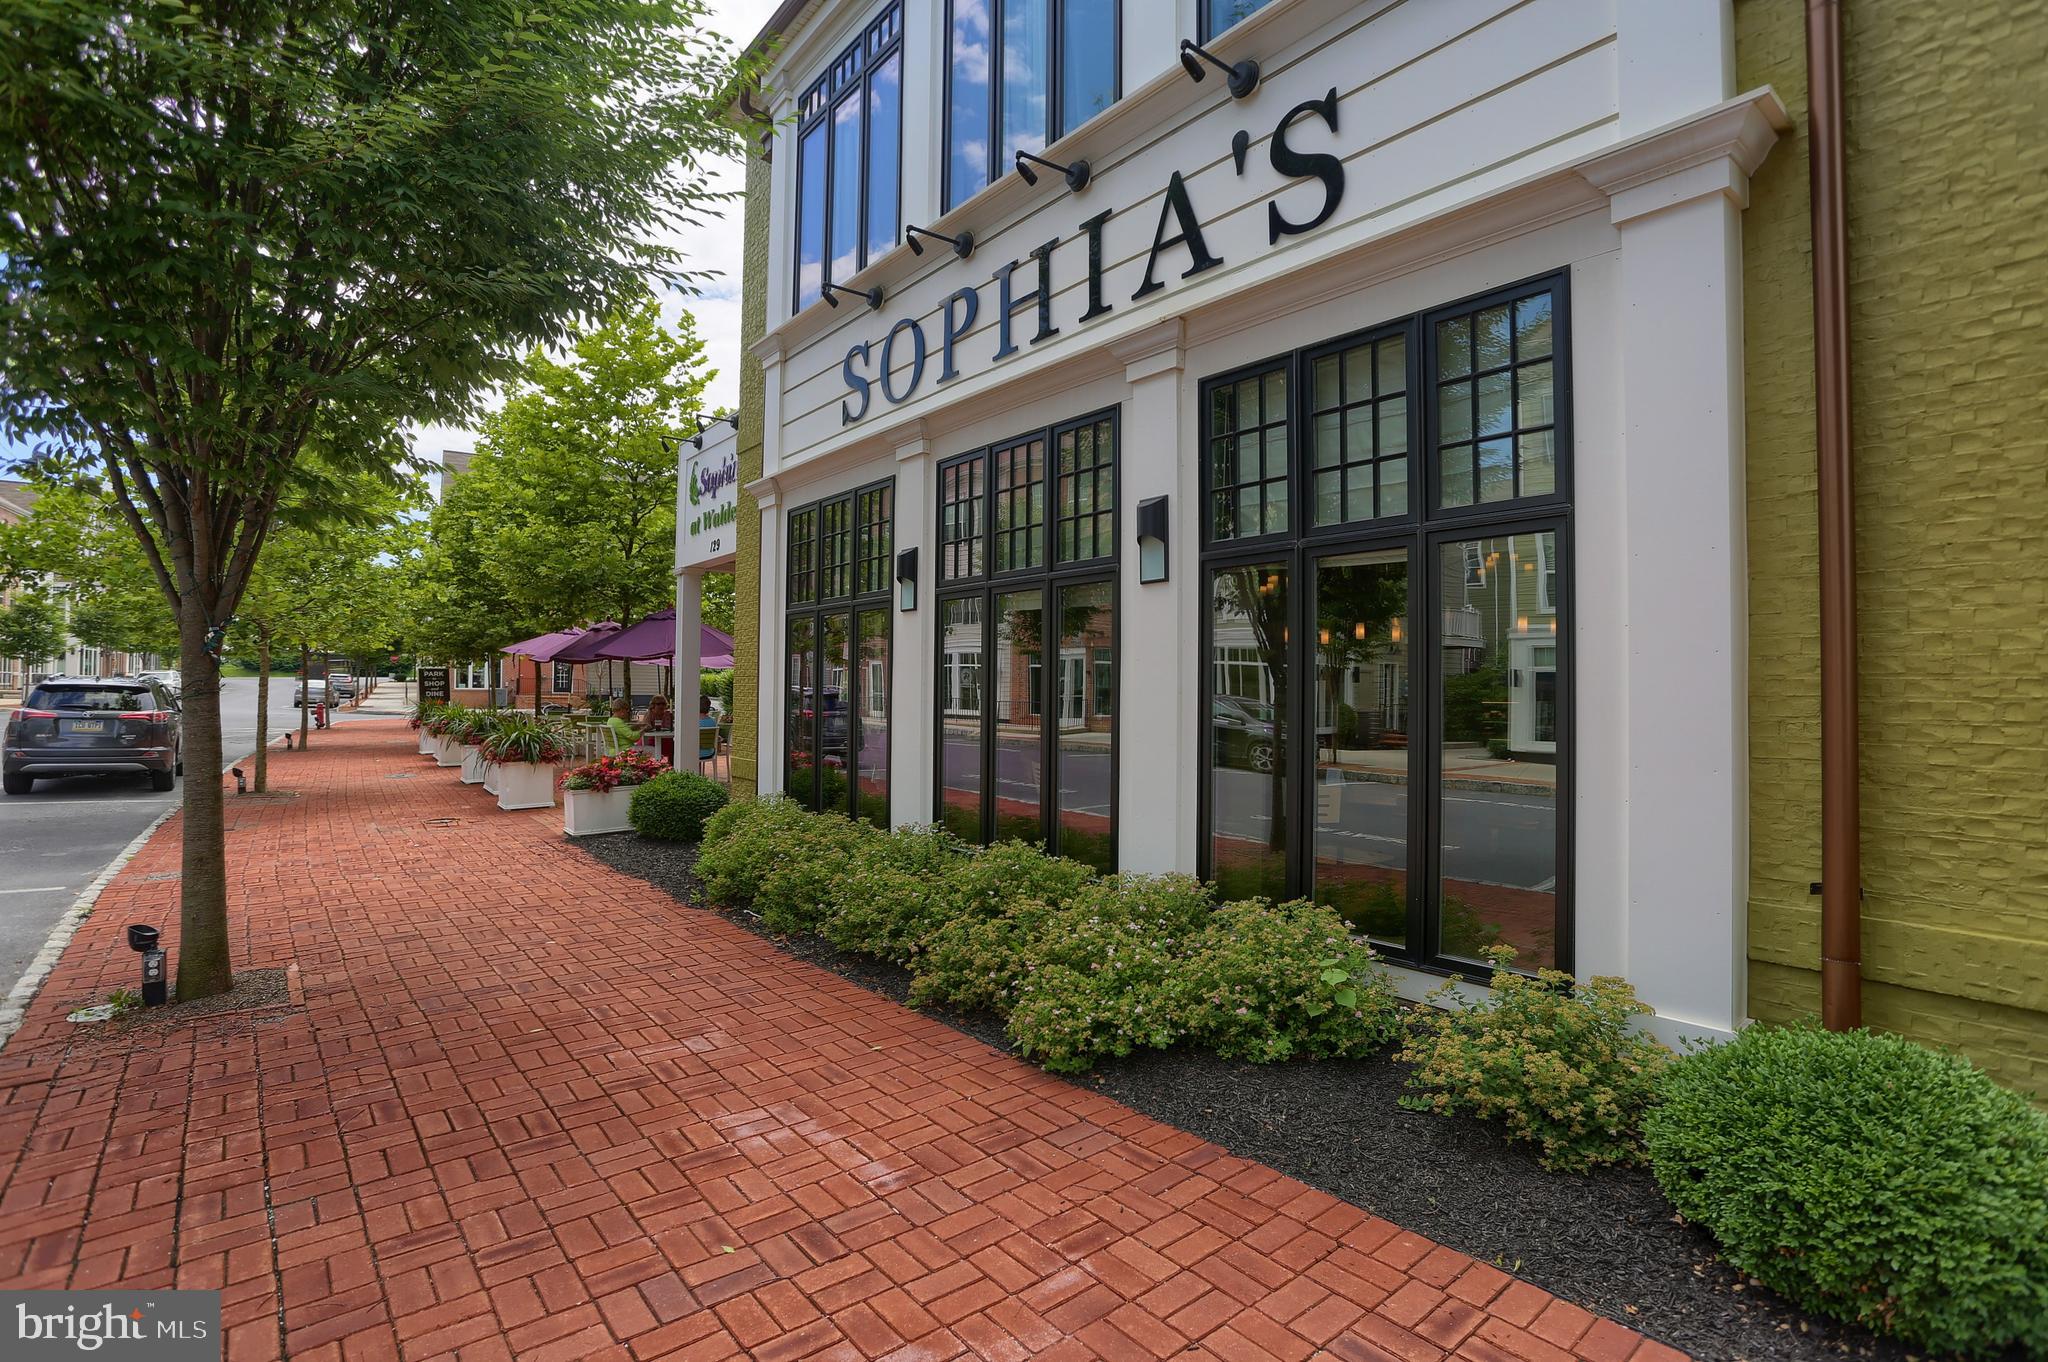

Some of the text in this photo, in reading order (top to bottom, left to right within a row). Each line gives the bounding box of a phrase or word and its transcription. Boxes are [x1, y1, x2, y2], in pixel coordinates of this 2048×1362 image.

[842, 87, 1346, 427] SOPHIA'S
[690, 516, 700, 536] at
[710, 538, 720, 553] 129
